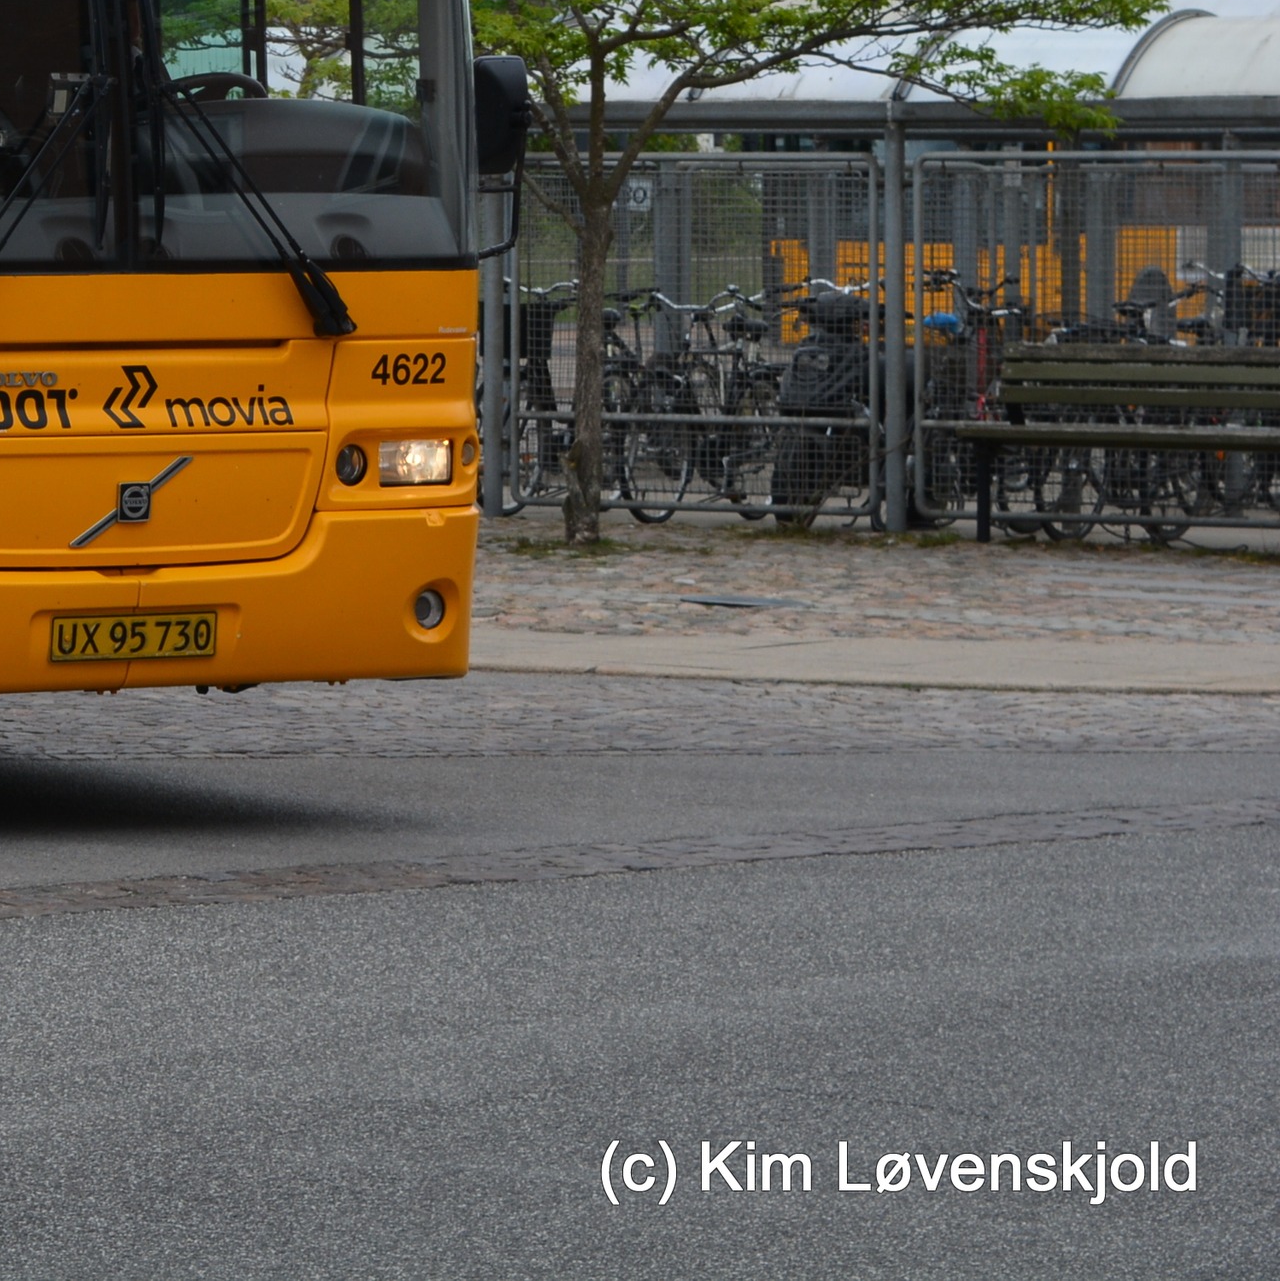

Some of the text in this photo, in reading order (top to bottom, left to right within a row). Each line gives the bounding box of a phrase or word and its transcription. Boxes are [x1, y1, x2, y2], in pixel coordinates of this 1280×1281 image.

[371, 352, 446, 386] 4622
[165, 384, 294, 428] movia
[57, 619, 211, 655] UX 95 730
